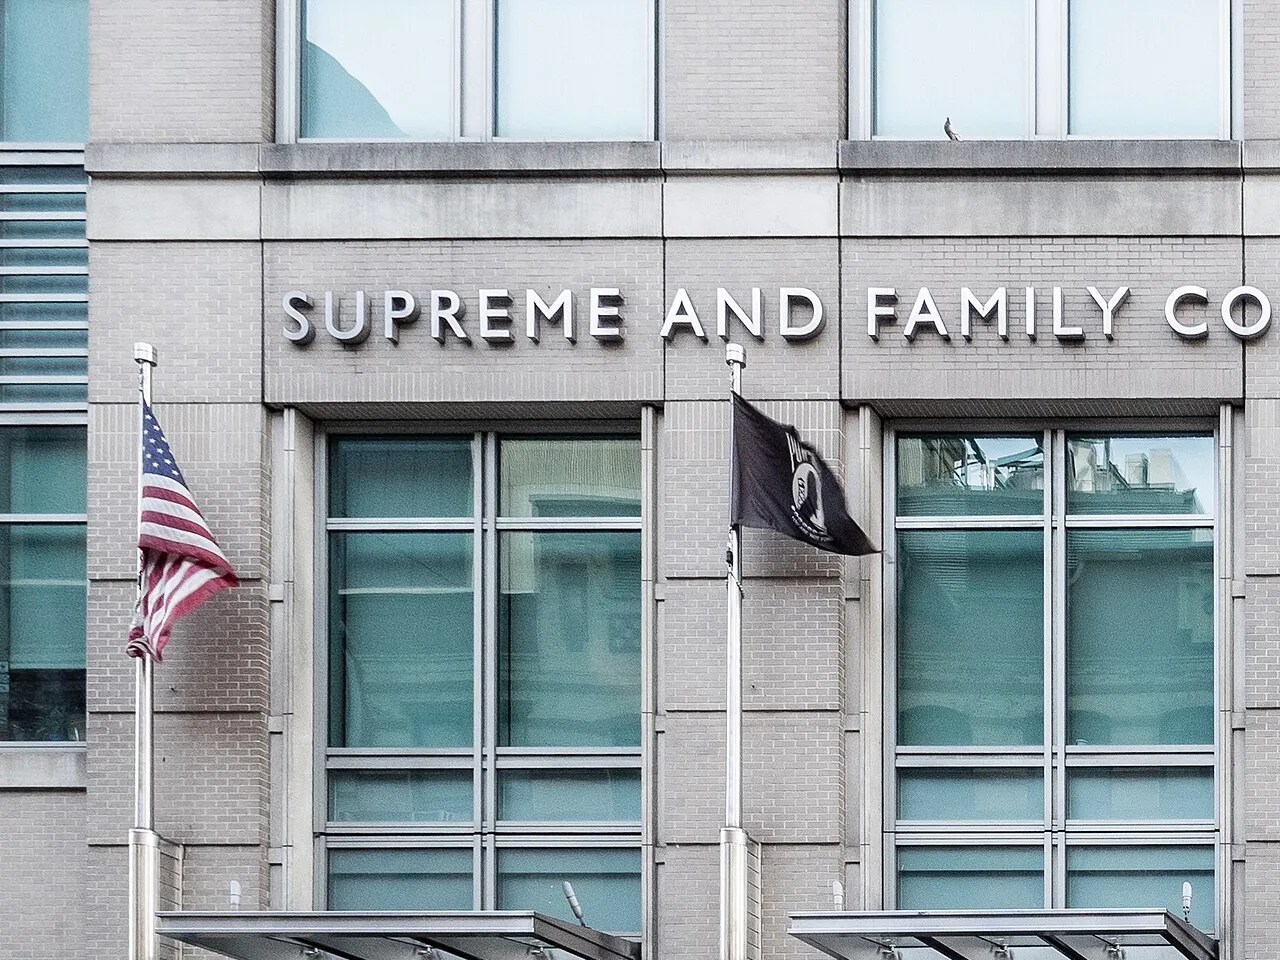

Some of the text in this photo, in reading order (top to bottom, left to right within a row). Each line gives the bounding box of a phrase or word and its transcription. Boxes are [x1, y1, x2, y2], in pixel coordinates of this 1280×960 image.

[282, 287, 626, 346] SUPREME
[661, 287, 827, 344] AND
[867, 285, 1131, 342] FAMILY
